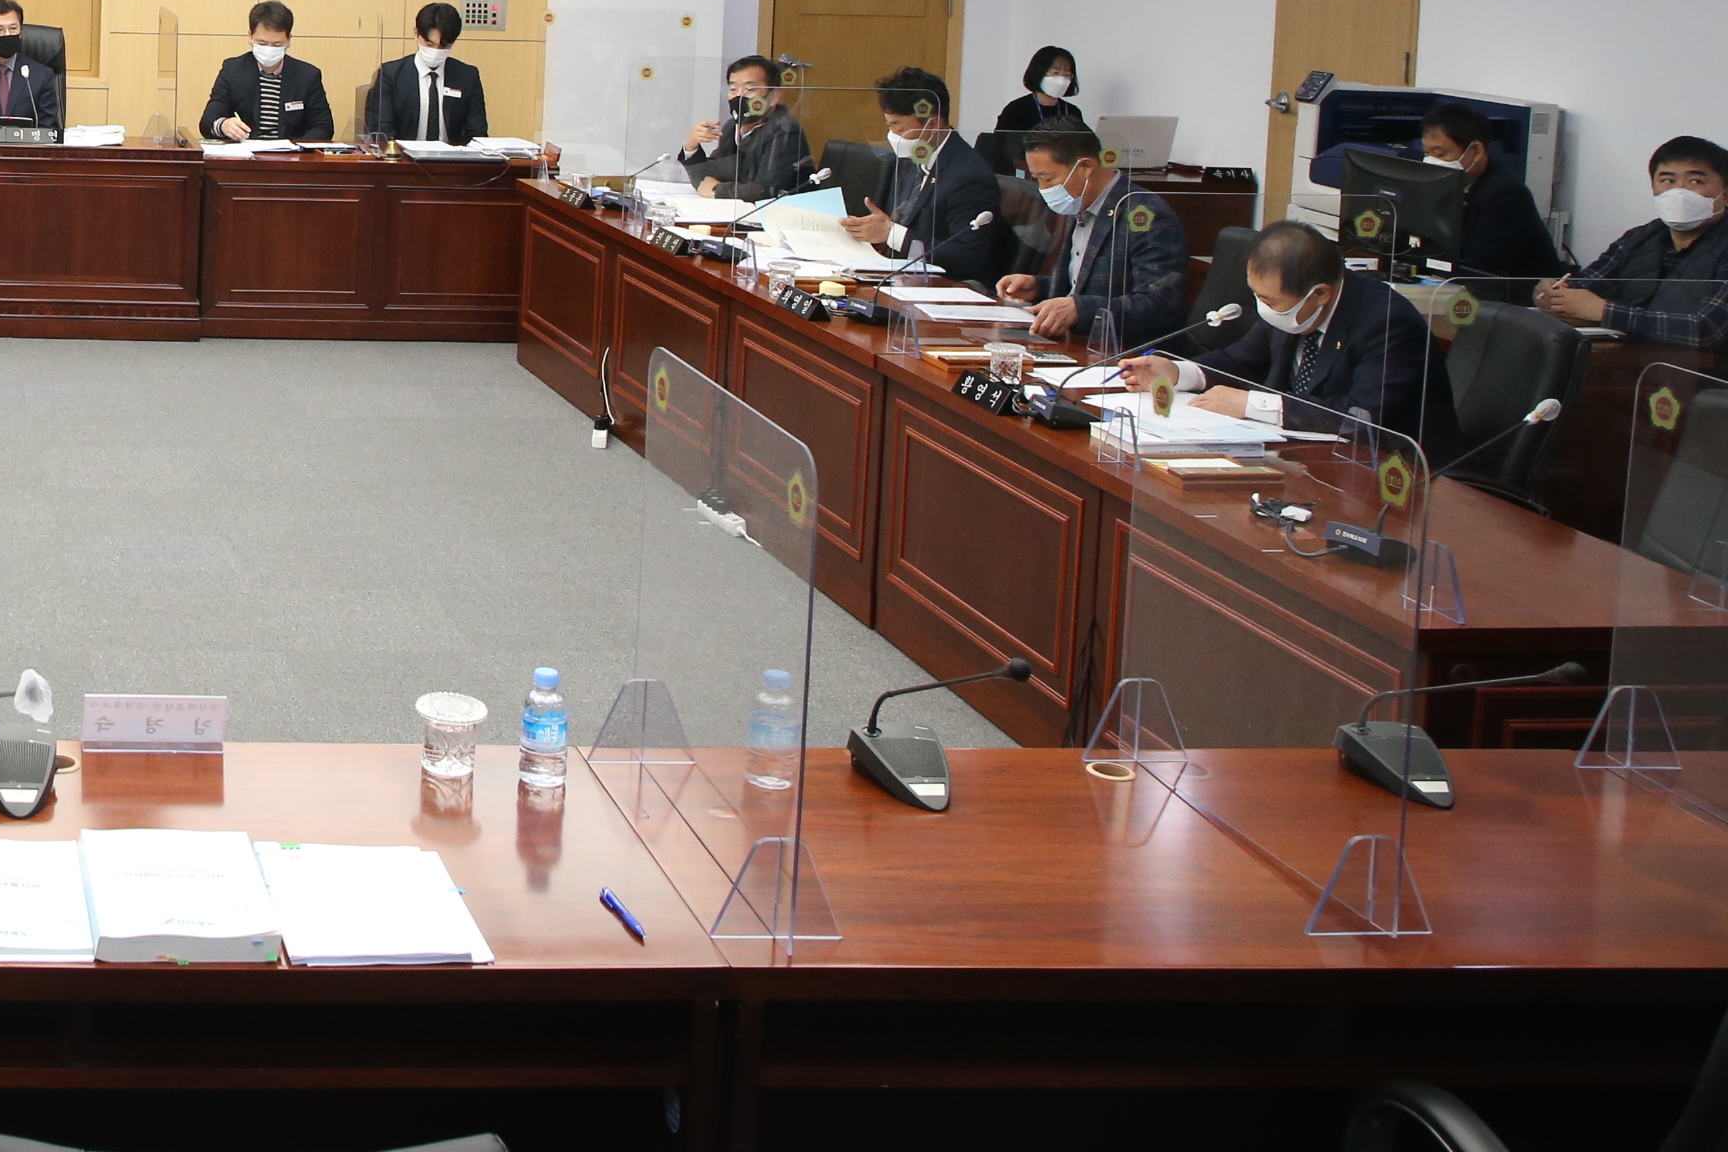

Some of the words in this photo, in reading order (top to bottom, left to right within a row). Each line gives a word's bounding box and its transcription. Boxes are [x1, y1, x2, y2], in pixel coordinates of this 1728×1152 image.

[13, 129, 60, 142] 이명연
[1212, 169, 1251, 179] 속기사
[781, 289, 814, 315] 최영일
[961, 375, 1003, 409] 황영석
